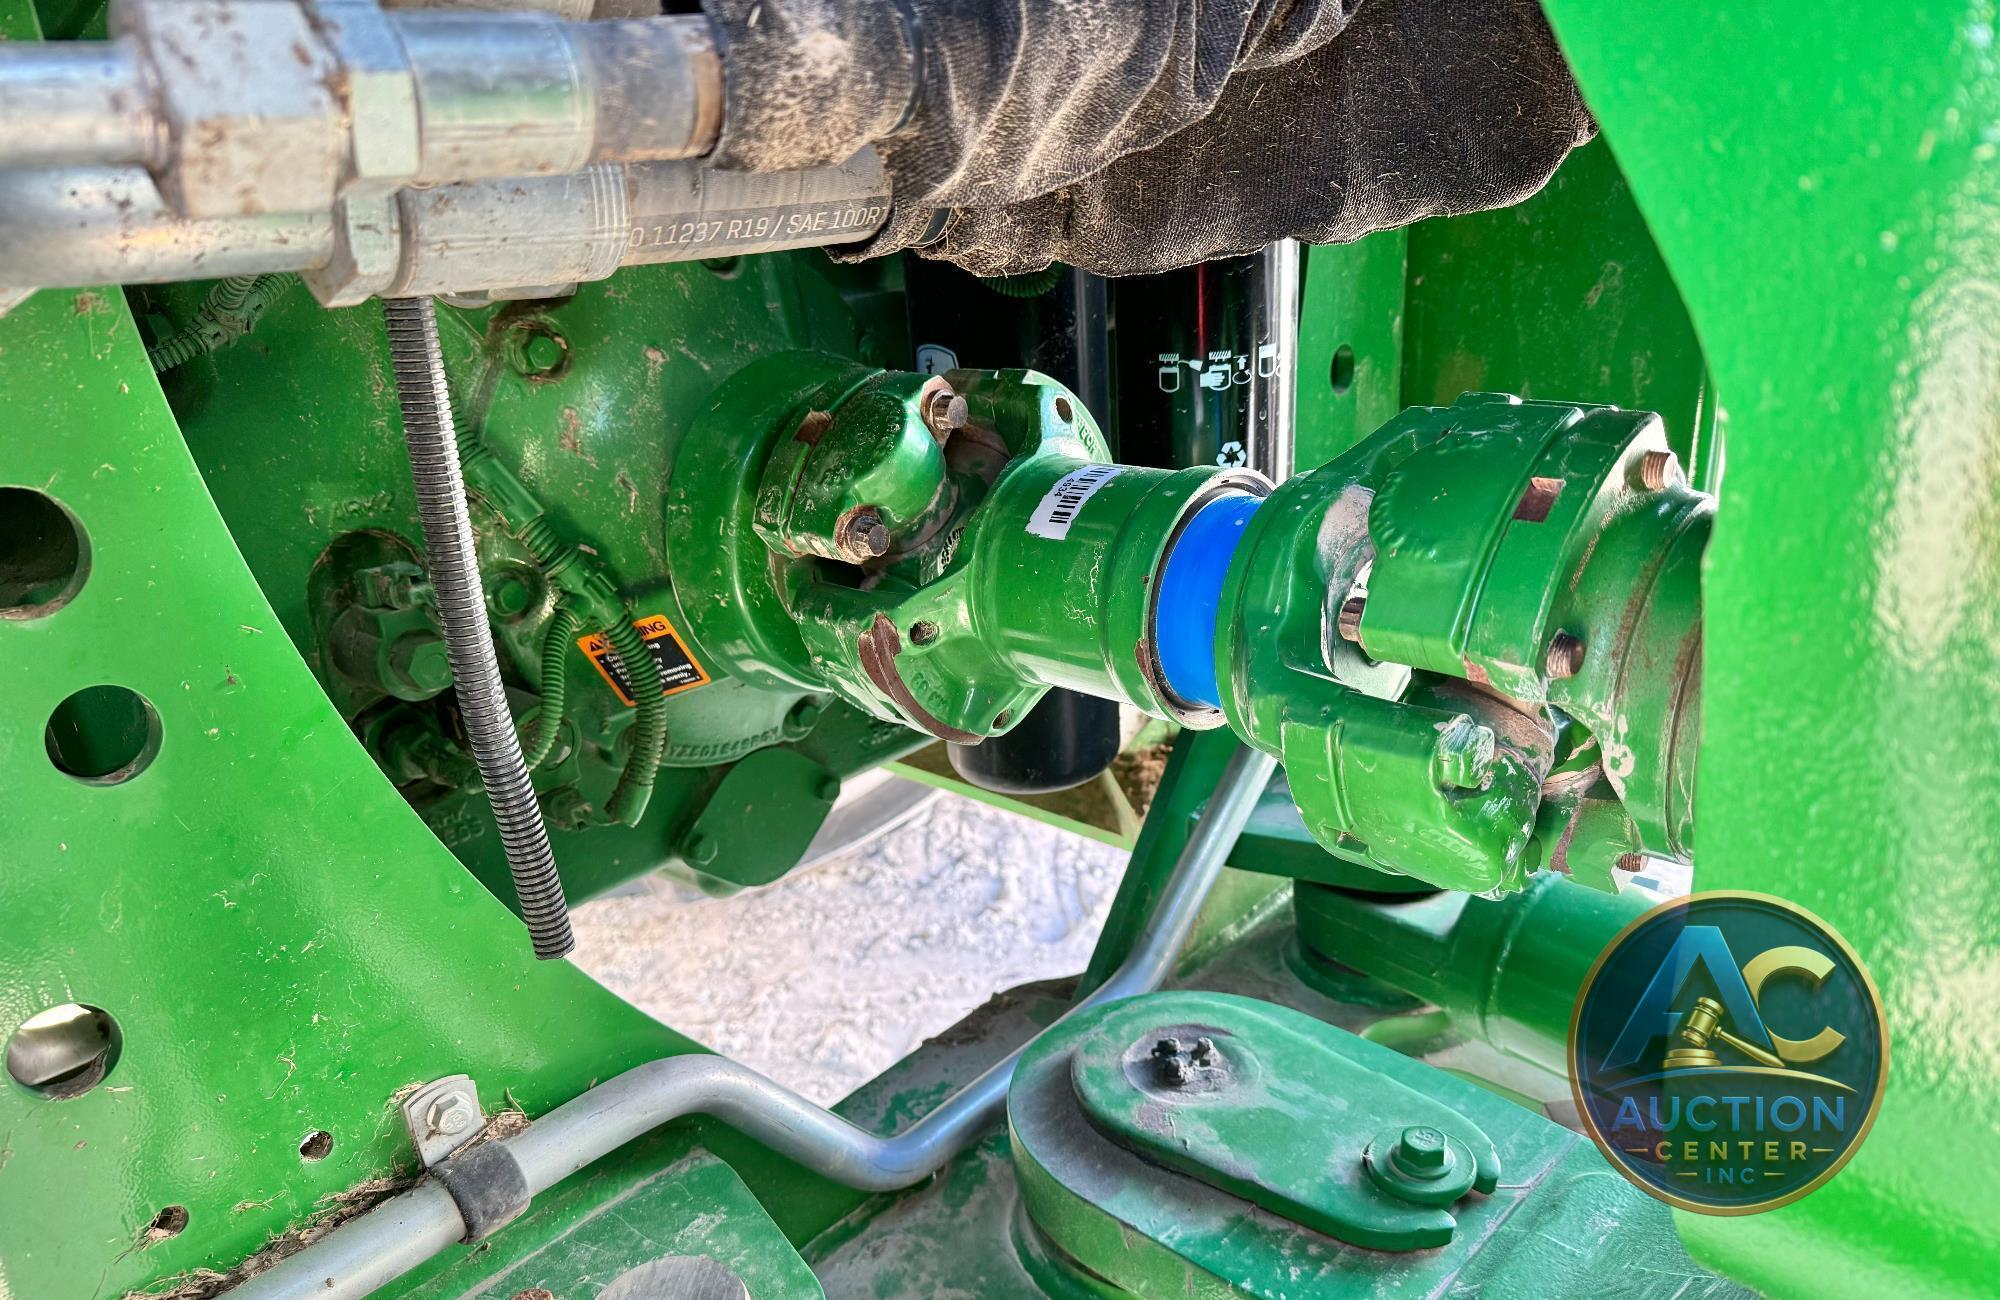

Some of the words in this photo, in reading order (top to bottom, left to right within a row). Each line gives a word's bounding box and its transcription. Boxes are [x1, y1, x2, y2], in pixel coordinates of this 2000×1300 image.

[653, 220, 723, 246] 11237
[726, 217, 769, 240] R19
[769, 214, 784, 238] /
[786, 211, 829, 235] SAE
